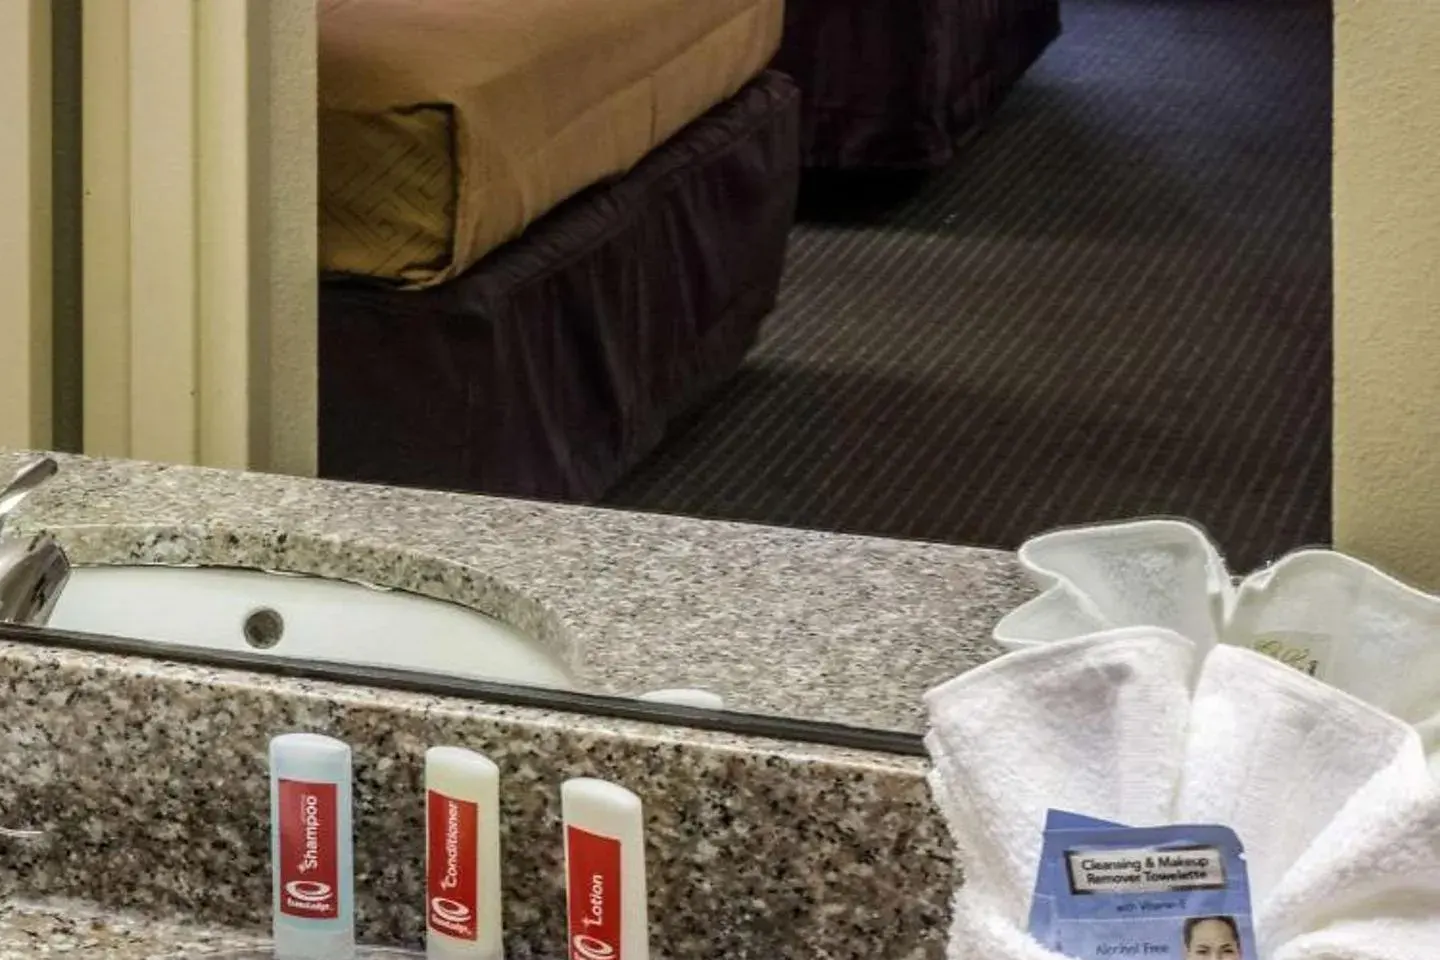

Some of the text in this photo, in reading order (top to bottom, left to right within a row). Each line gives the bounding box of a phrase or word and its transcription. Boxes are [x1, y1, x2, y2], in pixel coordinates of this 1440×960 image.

[304, 794, 320, 869] Shampoo
[445, 801, 459, 888] Conditioner
[1081, 855, 1209, 872] Cleansing & Makeup
[1086, 869, 1208, 885] Remover Towelette
[589, 874, 604, 927] Lotion
